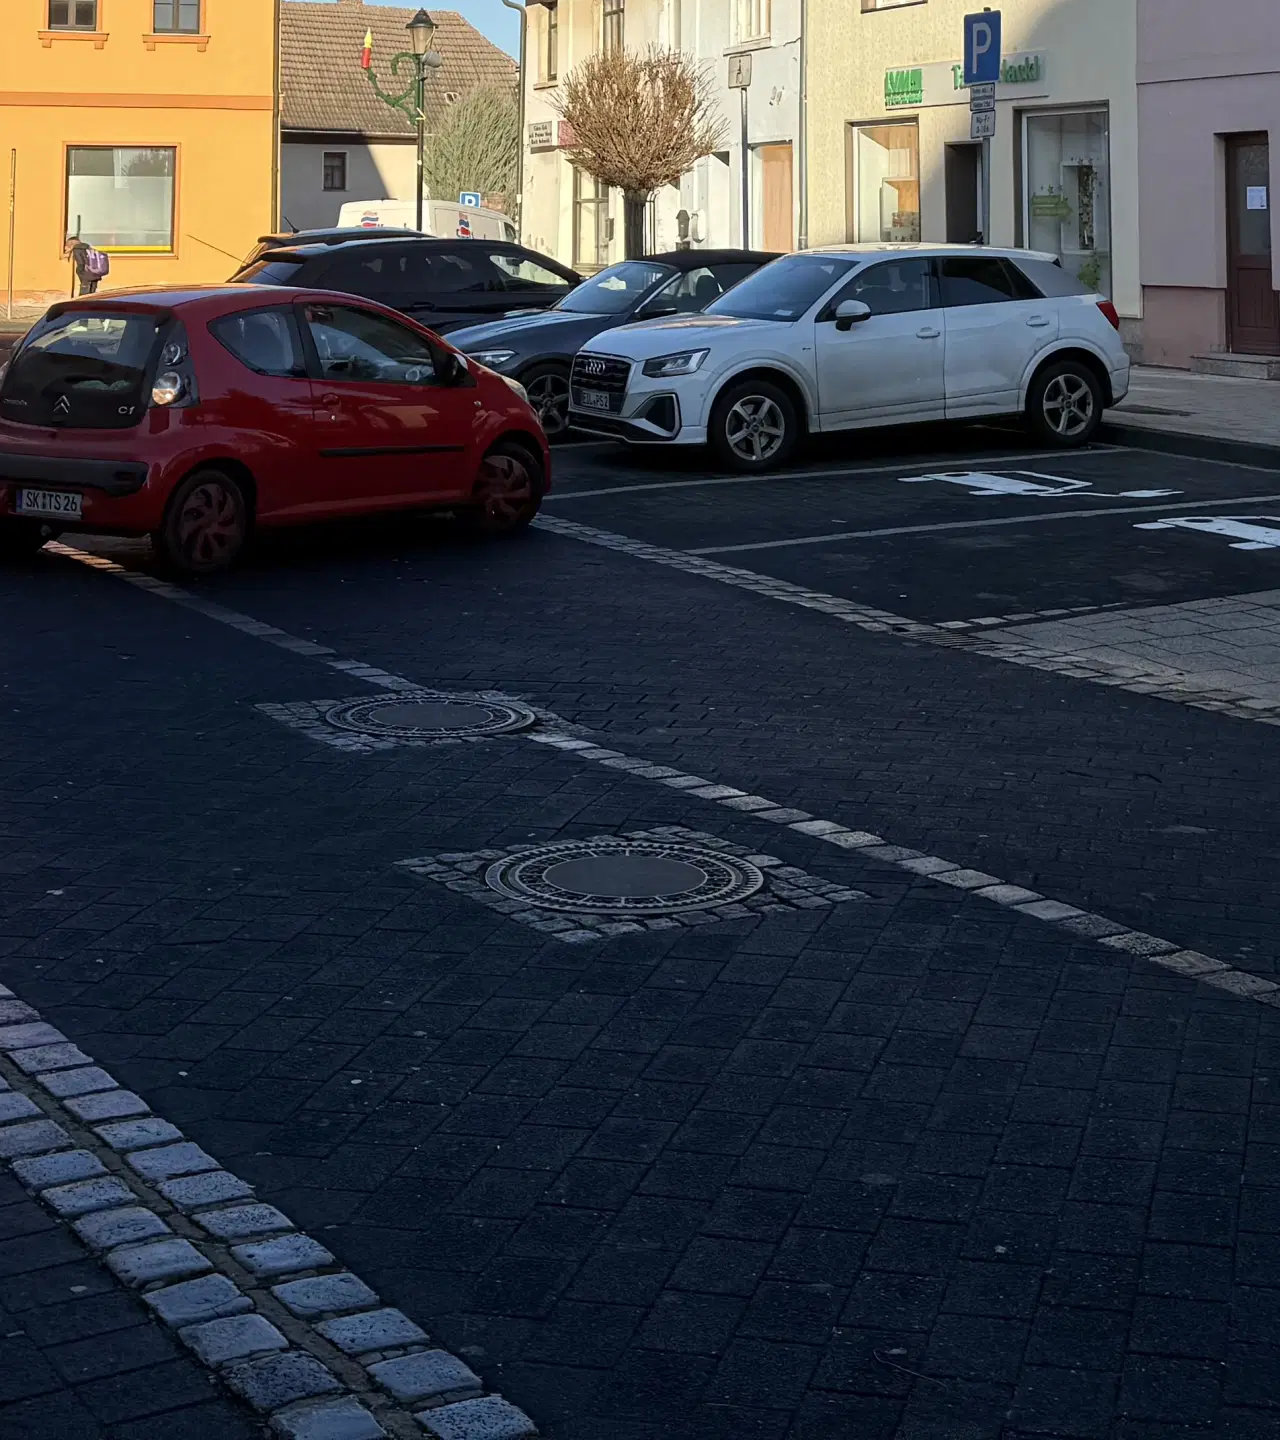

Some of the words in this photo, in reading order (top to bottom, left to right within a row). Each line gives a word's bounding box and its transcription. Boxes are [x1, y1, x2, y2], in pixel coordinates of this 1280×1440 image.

[972, 22, 992, 74] P
[118, 406, 135, 415] C1
[26, 491, 39, 509] SK
[47, 494, 61, 511] TS
[63, 495, 77, 512] 26
